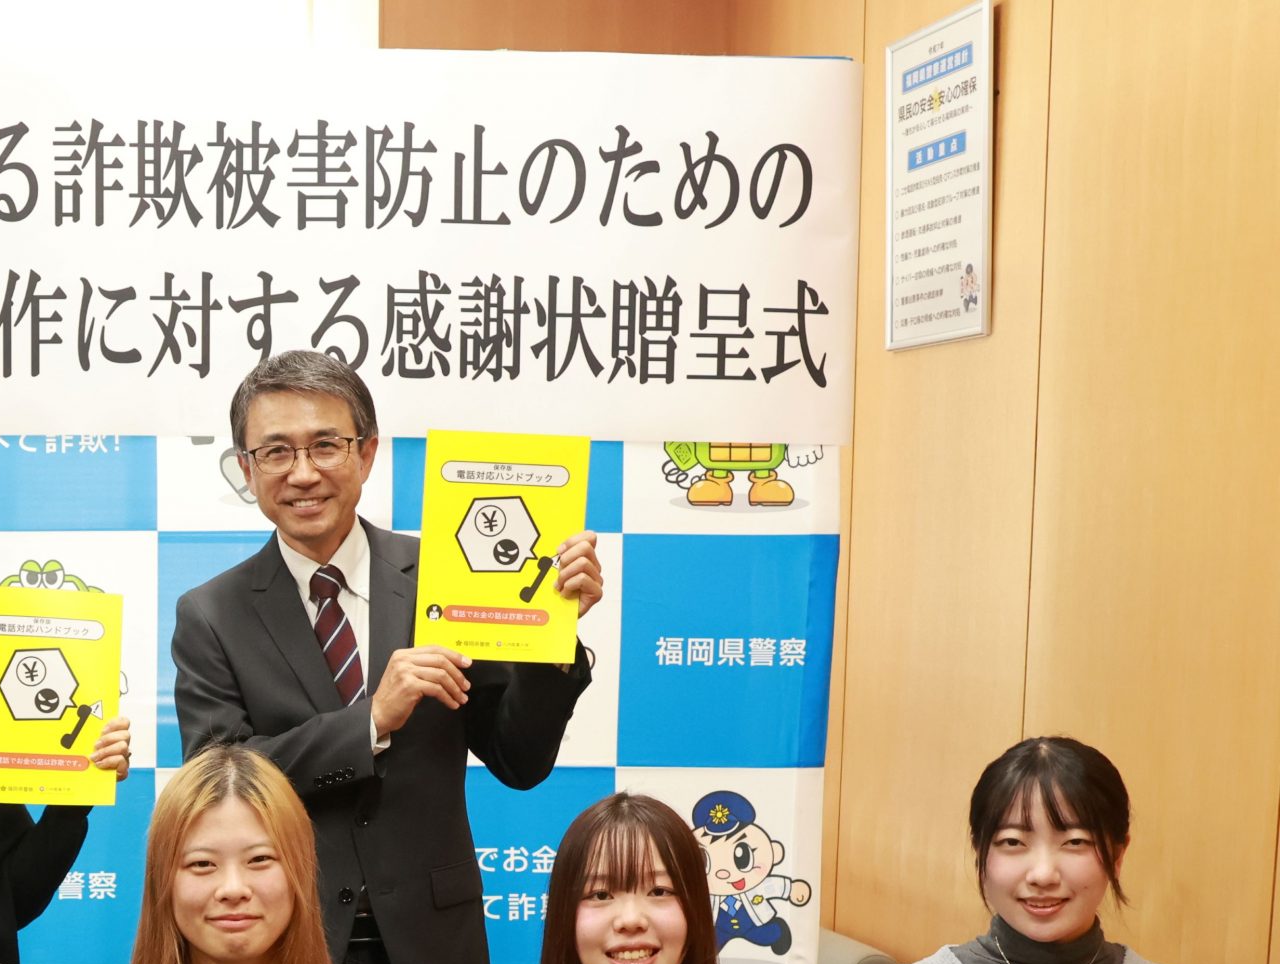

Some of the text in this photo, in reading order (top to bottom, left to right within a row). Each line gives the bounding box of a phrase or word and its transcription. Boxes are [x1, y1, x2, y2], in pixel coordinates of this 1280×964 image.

[457, 470, 553, 482] 電話対応ハンドブック
[452, 610, 541, 622] 電話でお金の話は詐欺です。
[655, 636, 806, 666] 福岡県警察
